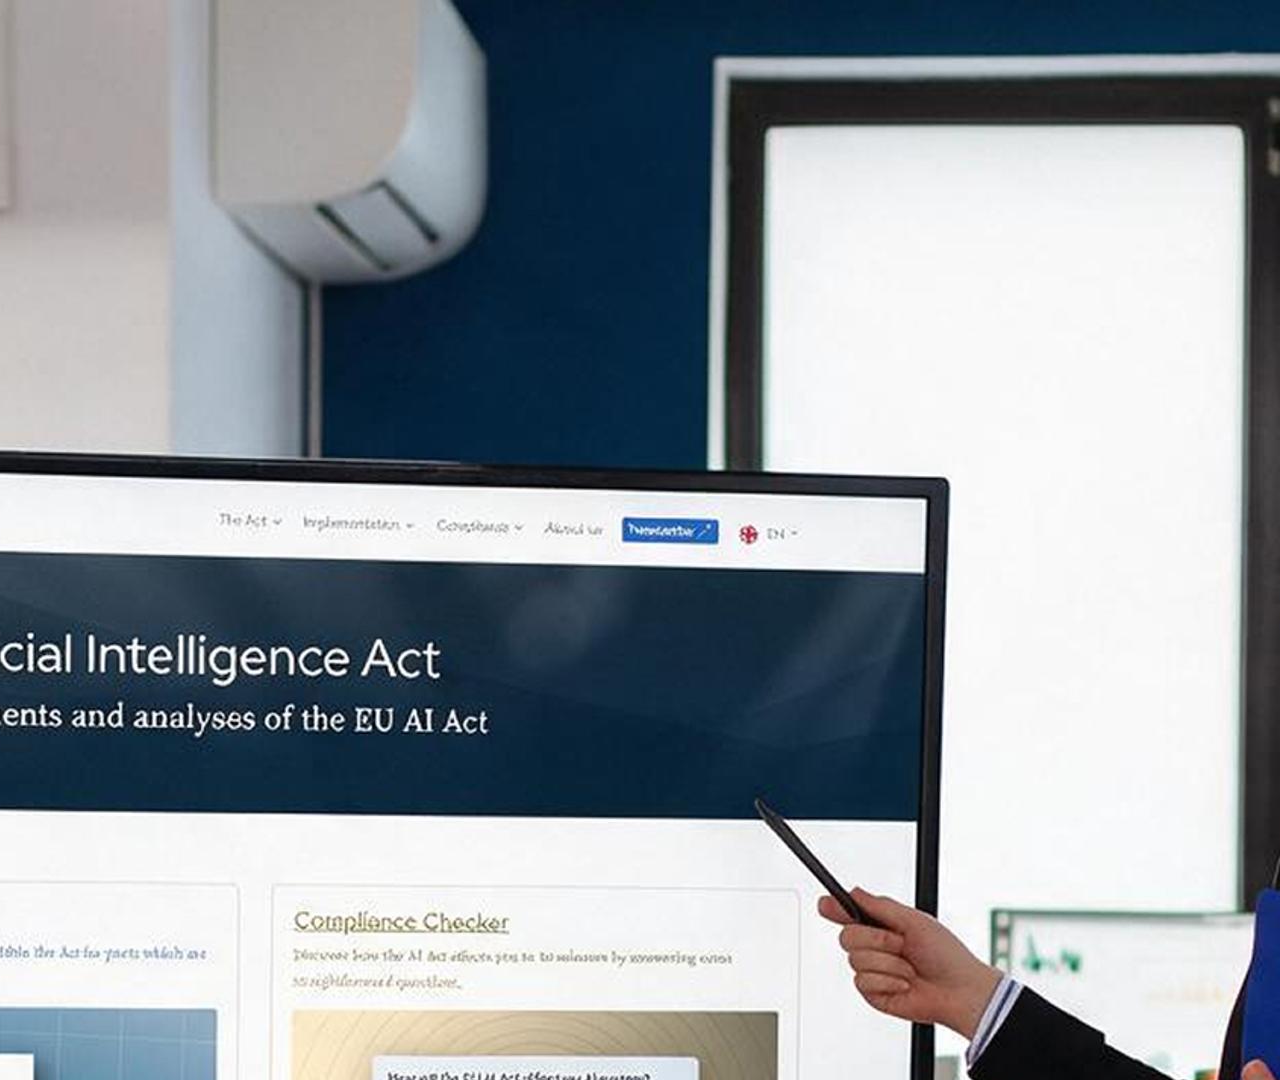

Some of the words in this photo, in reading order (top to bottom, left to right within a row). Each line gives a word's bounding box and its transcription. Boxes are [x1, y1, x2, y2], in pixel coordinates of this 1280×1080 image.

[87, 634, 349, 686] Intelligence
[361, 637, 441, 680] Act
[71, 702, 123, 729] and
[133, 703, 255, 738] analyses
[265, 704, 294, 731] of
[303, 706, 345, 732] the
[355, 708, 394, 732] EU
[403, 709, 434, 733] AI
[442, 709, 488, 735] Act
[294, 911, 417, 935] Compliance
[423, 912, 510, 934] Checker
